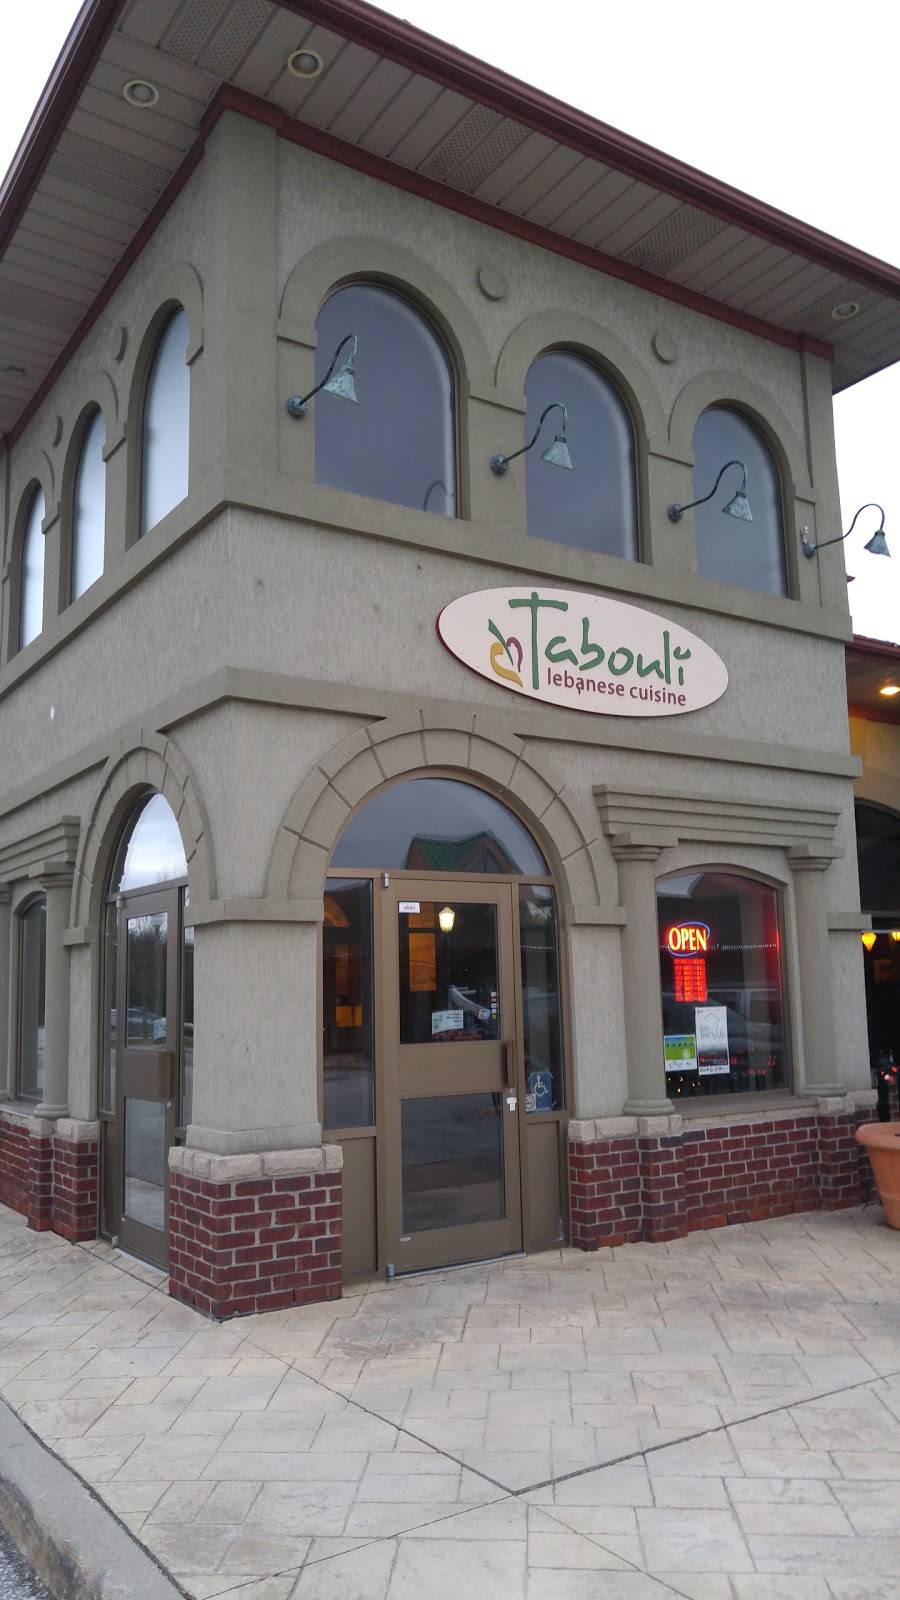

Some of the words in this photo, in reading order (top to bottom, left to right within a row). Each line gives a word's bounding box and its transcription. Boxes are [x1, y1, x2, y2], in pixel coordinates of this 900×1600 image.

[508, 591, 692, 690] Tabouli
[547, 667, 625, 696] lebanese
[629, 685, 687, 706] cuisine
[668, 927, 707, 951] OPEN
